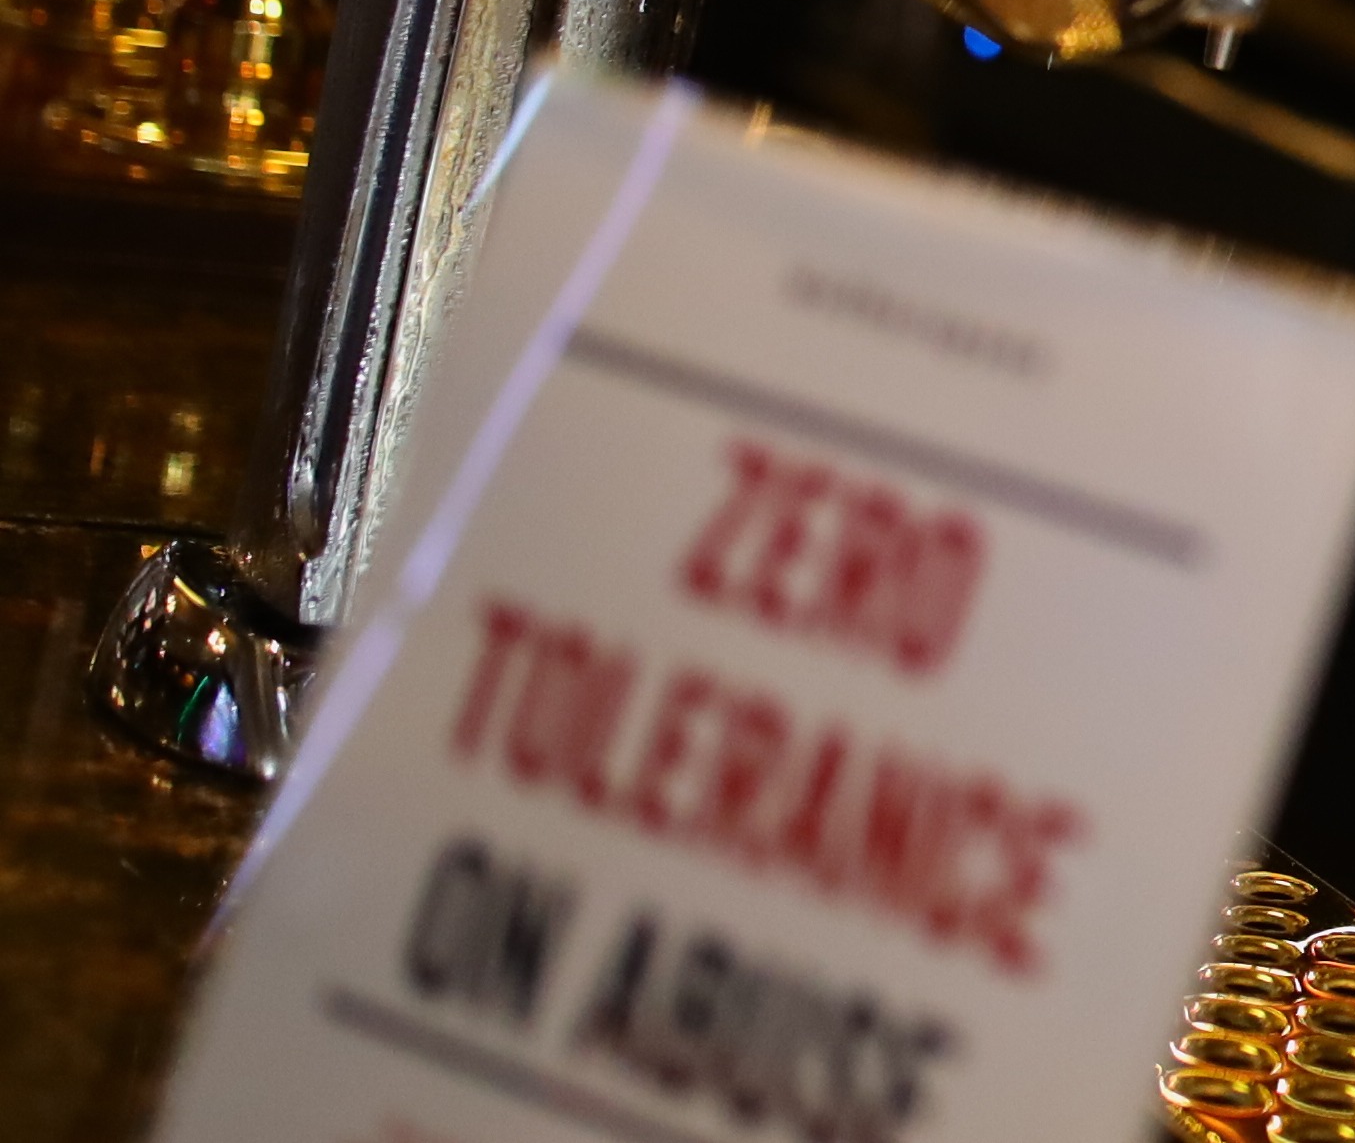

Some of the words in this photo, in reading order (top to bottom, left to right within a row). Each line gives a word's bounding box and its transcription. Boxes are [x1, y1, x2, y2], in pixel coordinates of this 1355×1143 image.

[683, 439, 987, 685] ZERO
[448, 593, 1090, 987] TOLERANCE
[402, 835, 584, 1033] ON
[570, 902, 966, 1143] ABUSE
